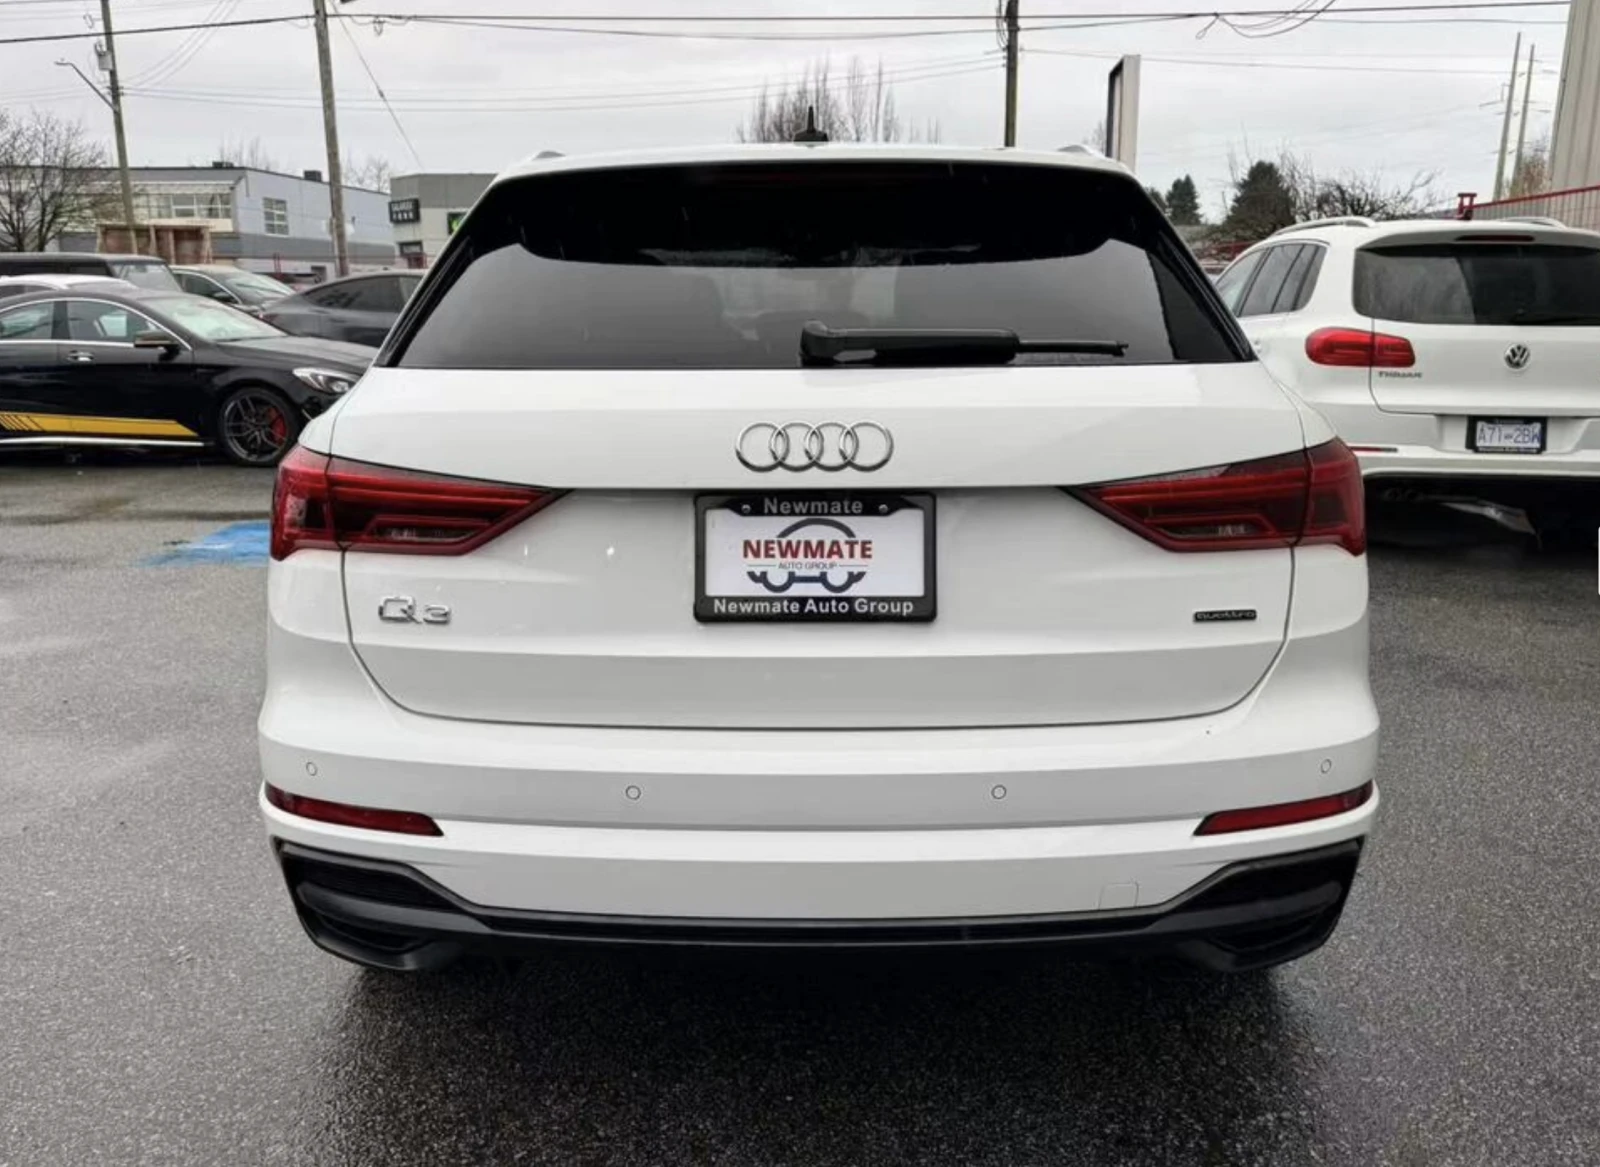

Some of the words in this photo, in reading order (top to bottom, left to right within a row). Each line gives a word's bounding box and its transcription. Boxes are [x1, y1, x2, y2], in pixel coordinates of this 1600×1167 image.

[764, 498, 863, 514] Newmate
[742, 539, 873, 559] NEWMATE
[778, 562, 803, 570] AUTO
[804, 562, 837, 570] GROUP
[378, 596, 452, 625] Q3
[713, 599, 800, 613] Newmate
[804, 599, 849, 613] Auto
[854, 599, 914, 616] Group
